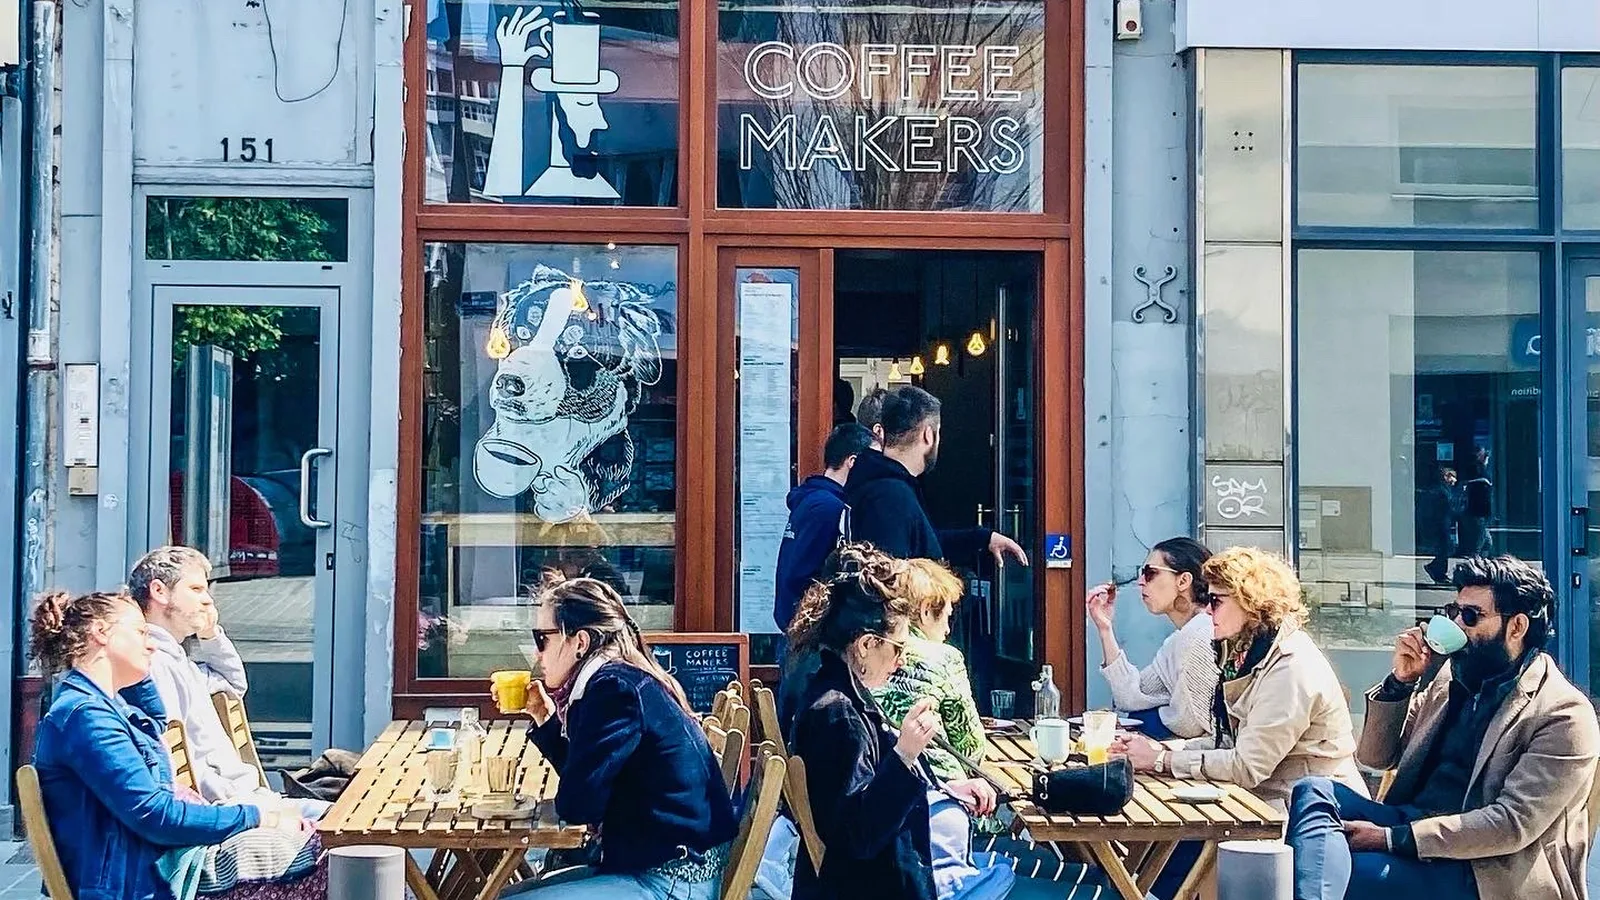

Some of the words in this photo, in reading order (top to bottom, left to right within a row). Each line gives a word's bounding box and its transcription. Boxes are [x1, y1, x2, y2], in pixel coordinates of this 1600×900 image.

[744, 41, 1021, 101] COFFEE
[220, 137, 273, 163] 151
[740, 113, 1024, 174] MAKERS
[686, 649, 728, 658] COFFEE
[686, 658, 729, 667] MAKERS
